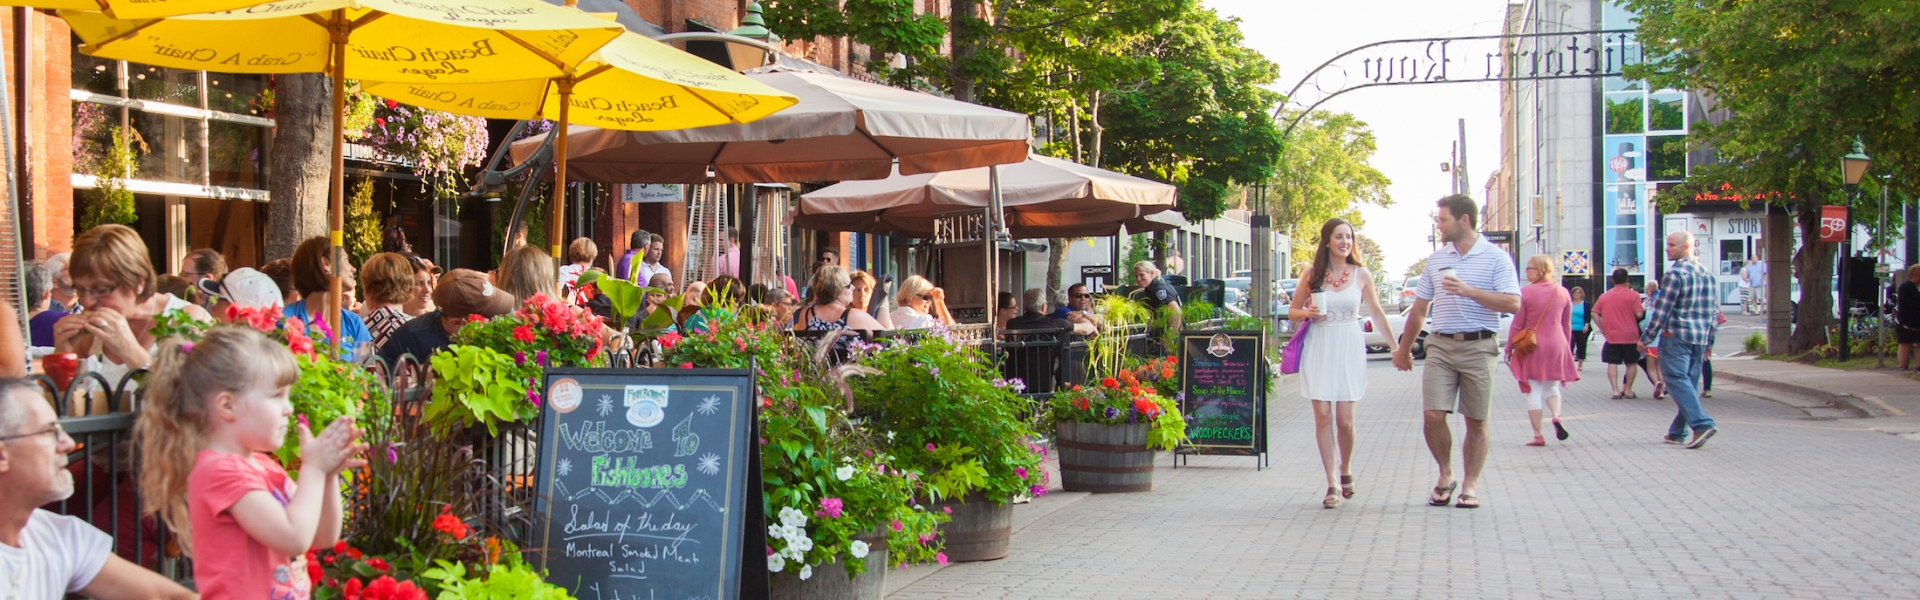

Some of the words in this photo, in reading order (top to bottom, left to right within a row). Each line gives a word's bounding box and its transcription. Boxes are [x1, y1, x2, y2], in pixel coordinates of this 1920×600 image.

[1728, 217, 1762, 234] STOR
[1192, 385, 1208, 395] Soup
[1217, 386, 1225, 395] the
[559, 420, 654, 453] Welcome
[671, 411, 701, 457] To
[1189, 426, 1251, 440] WOODPECKERS
[591, 453, 688, 490] Fishbones
[564, 504, 610, 534] Salad
[613, 513, 632, 544] of
[636, 512, 660, 533] the
[659, 512, 699, 549] day
[565, 542, 614, 559] Montreal
[662, 545, 701, 565] Meat
[609, 561, 646, 574] Salad
